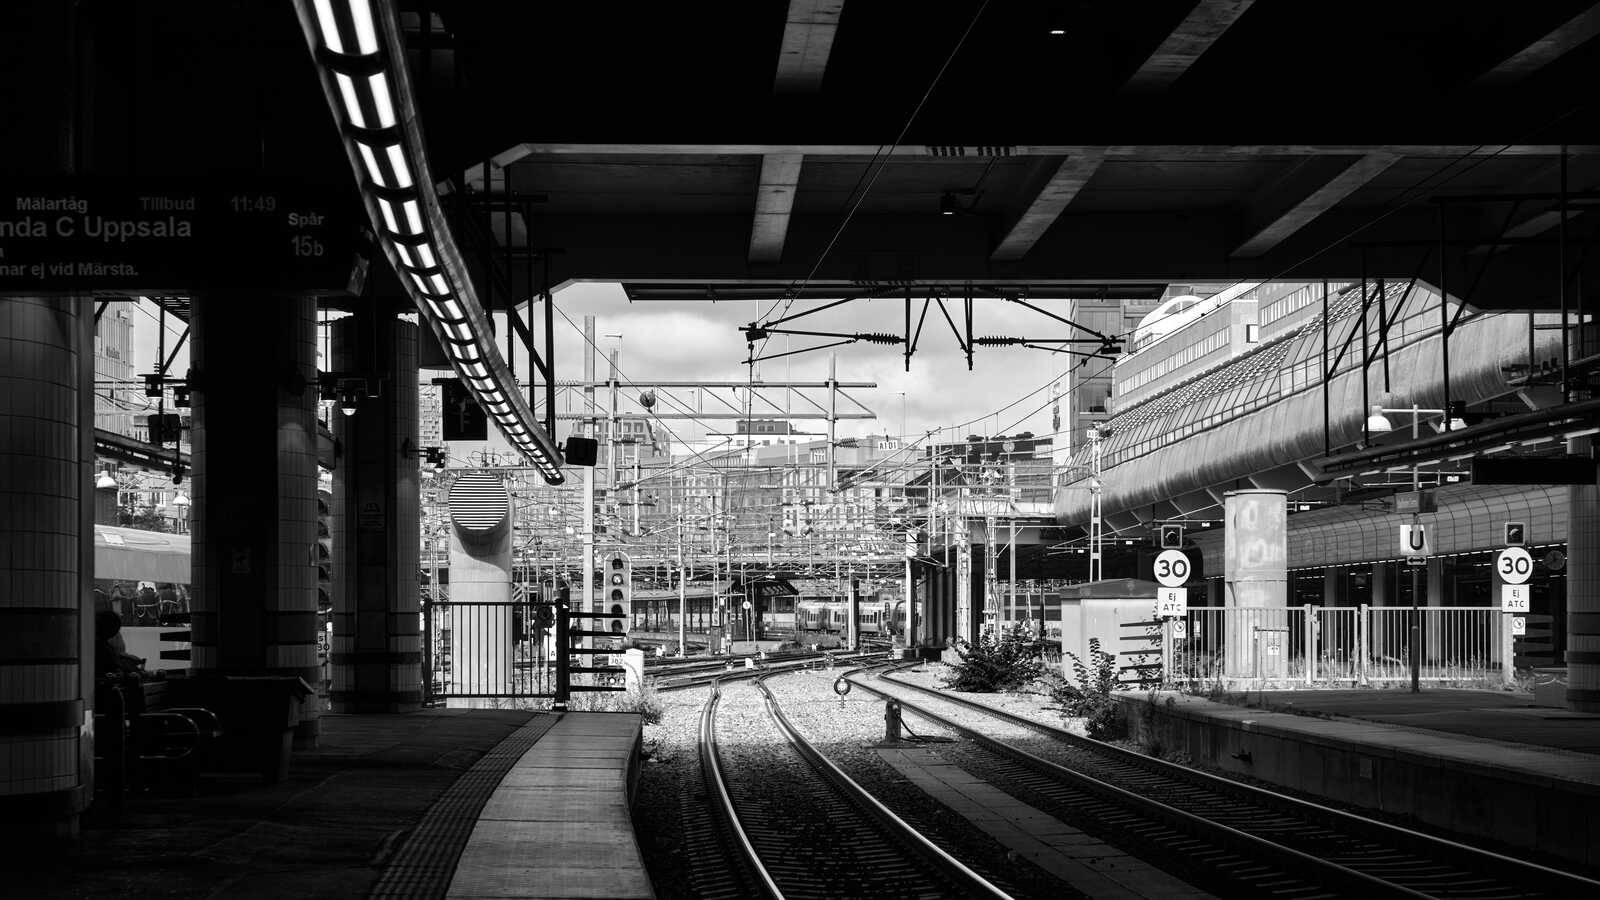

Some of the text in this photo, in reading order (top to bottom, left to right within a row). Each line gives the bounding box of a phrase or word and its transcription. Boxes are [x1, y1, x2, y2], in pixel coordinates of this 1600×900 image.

[16, 196, 88, 214] Mälartåg
[139, 196, 196, 212] Tillbud
[230, 195, 277, 212] 11:49
[56, 216, 75, 238] C
[84, 217, 193, 243] Uppsala
[288, 212, 325, 229] Spår
[31, 261, 46, 280] ej
[49, 261, 74, 277] vid
[78, 261, 138, 277] Märsta.
[1410, 530, 1424, 551] U
[1158, 559, 1187, 578] 30
[1502, 557, 1529, 575] 30
[1163, 604, 1182, 612] ATC
[1507, 600, 1524, 608] ATC
